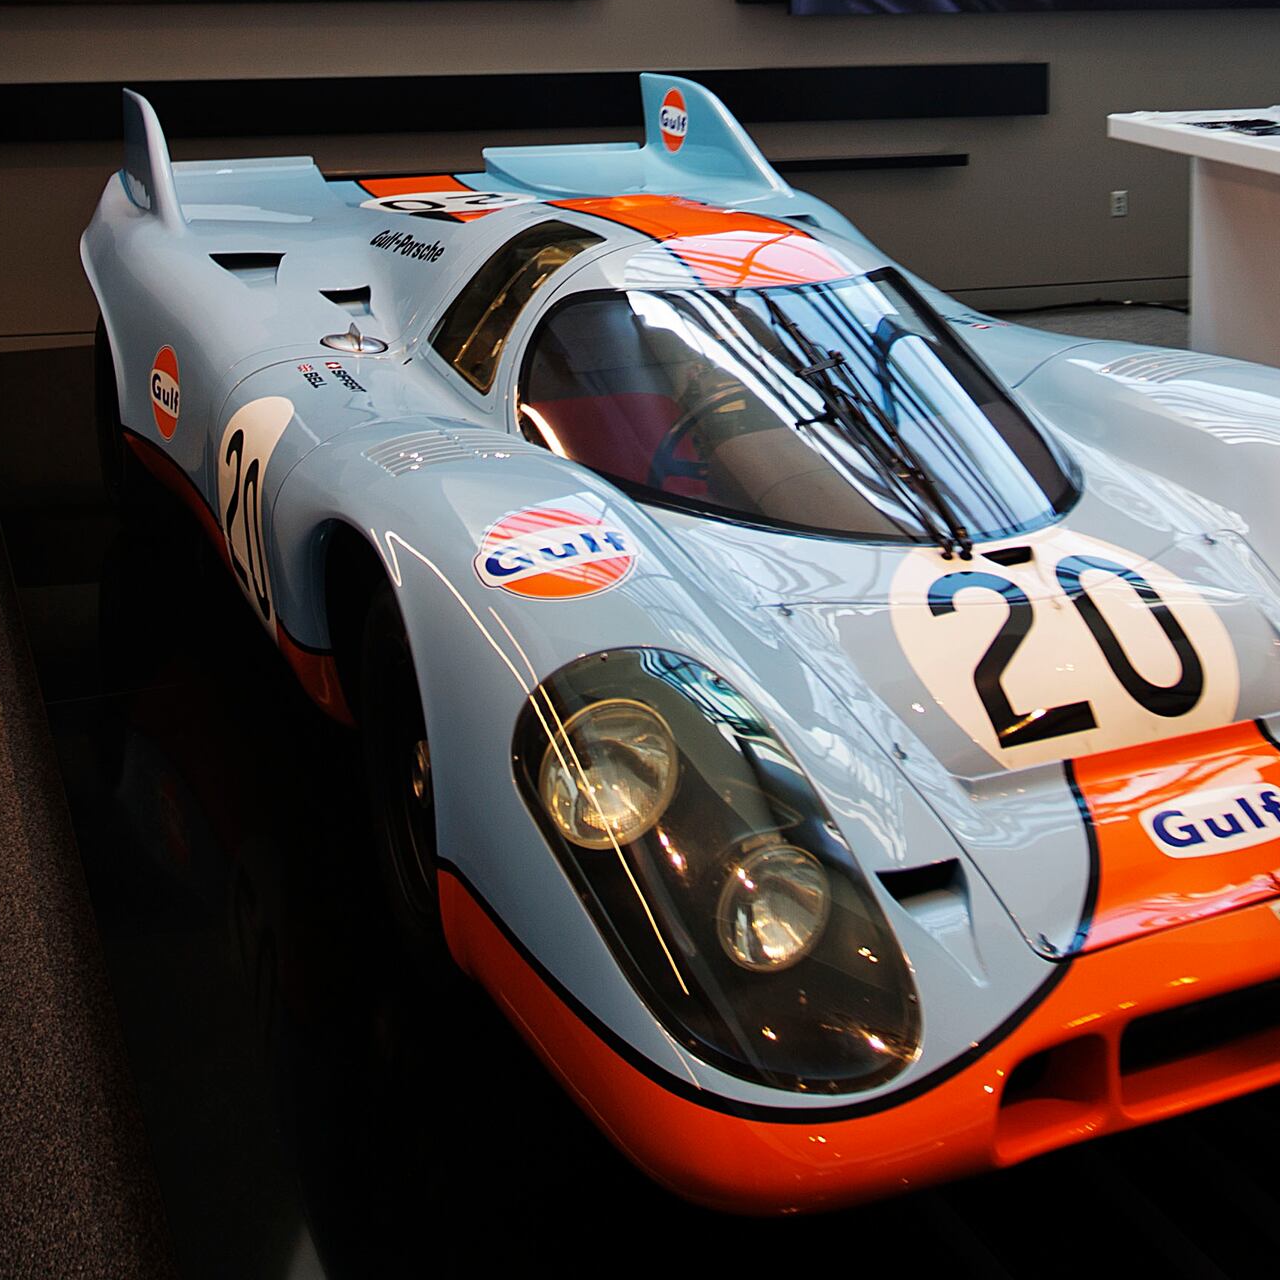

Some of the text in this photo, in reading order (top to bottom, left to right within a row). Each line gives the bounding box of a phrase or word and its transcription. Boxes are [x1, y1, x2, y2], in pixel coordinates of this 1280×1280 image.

[661, 109, 686, 131] Gulf
[369, 229, 445, 263] Gulf-Porsche
[151, 372, 179, 414] Gulf
[303, 372, 327, 388] BELL
[226, 428, 270, 621] 20
[485, 531, 626, 577] Gulf
[926, 554, 1205, 749] 20
